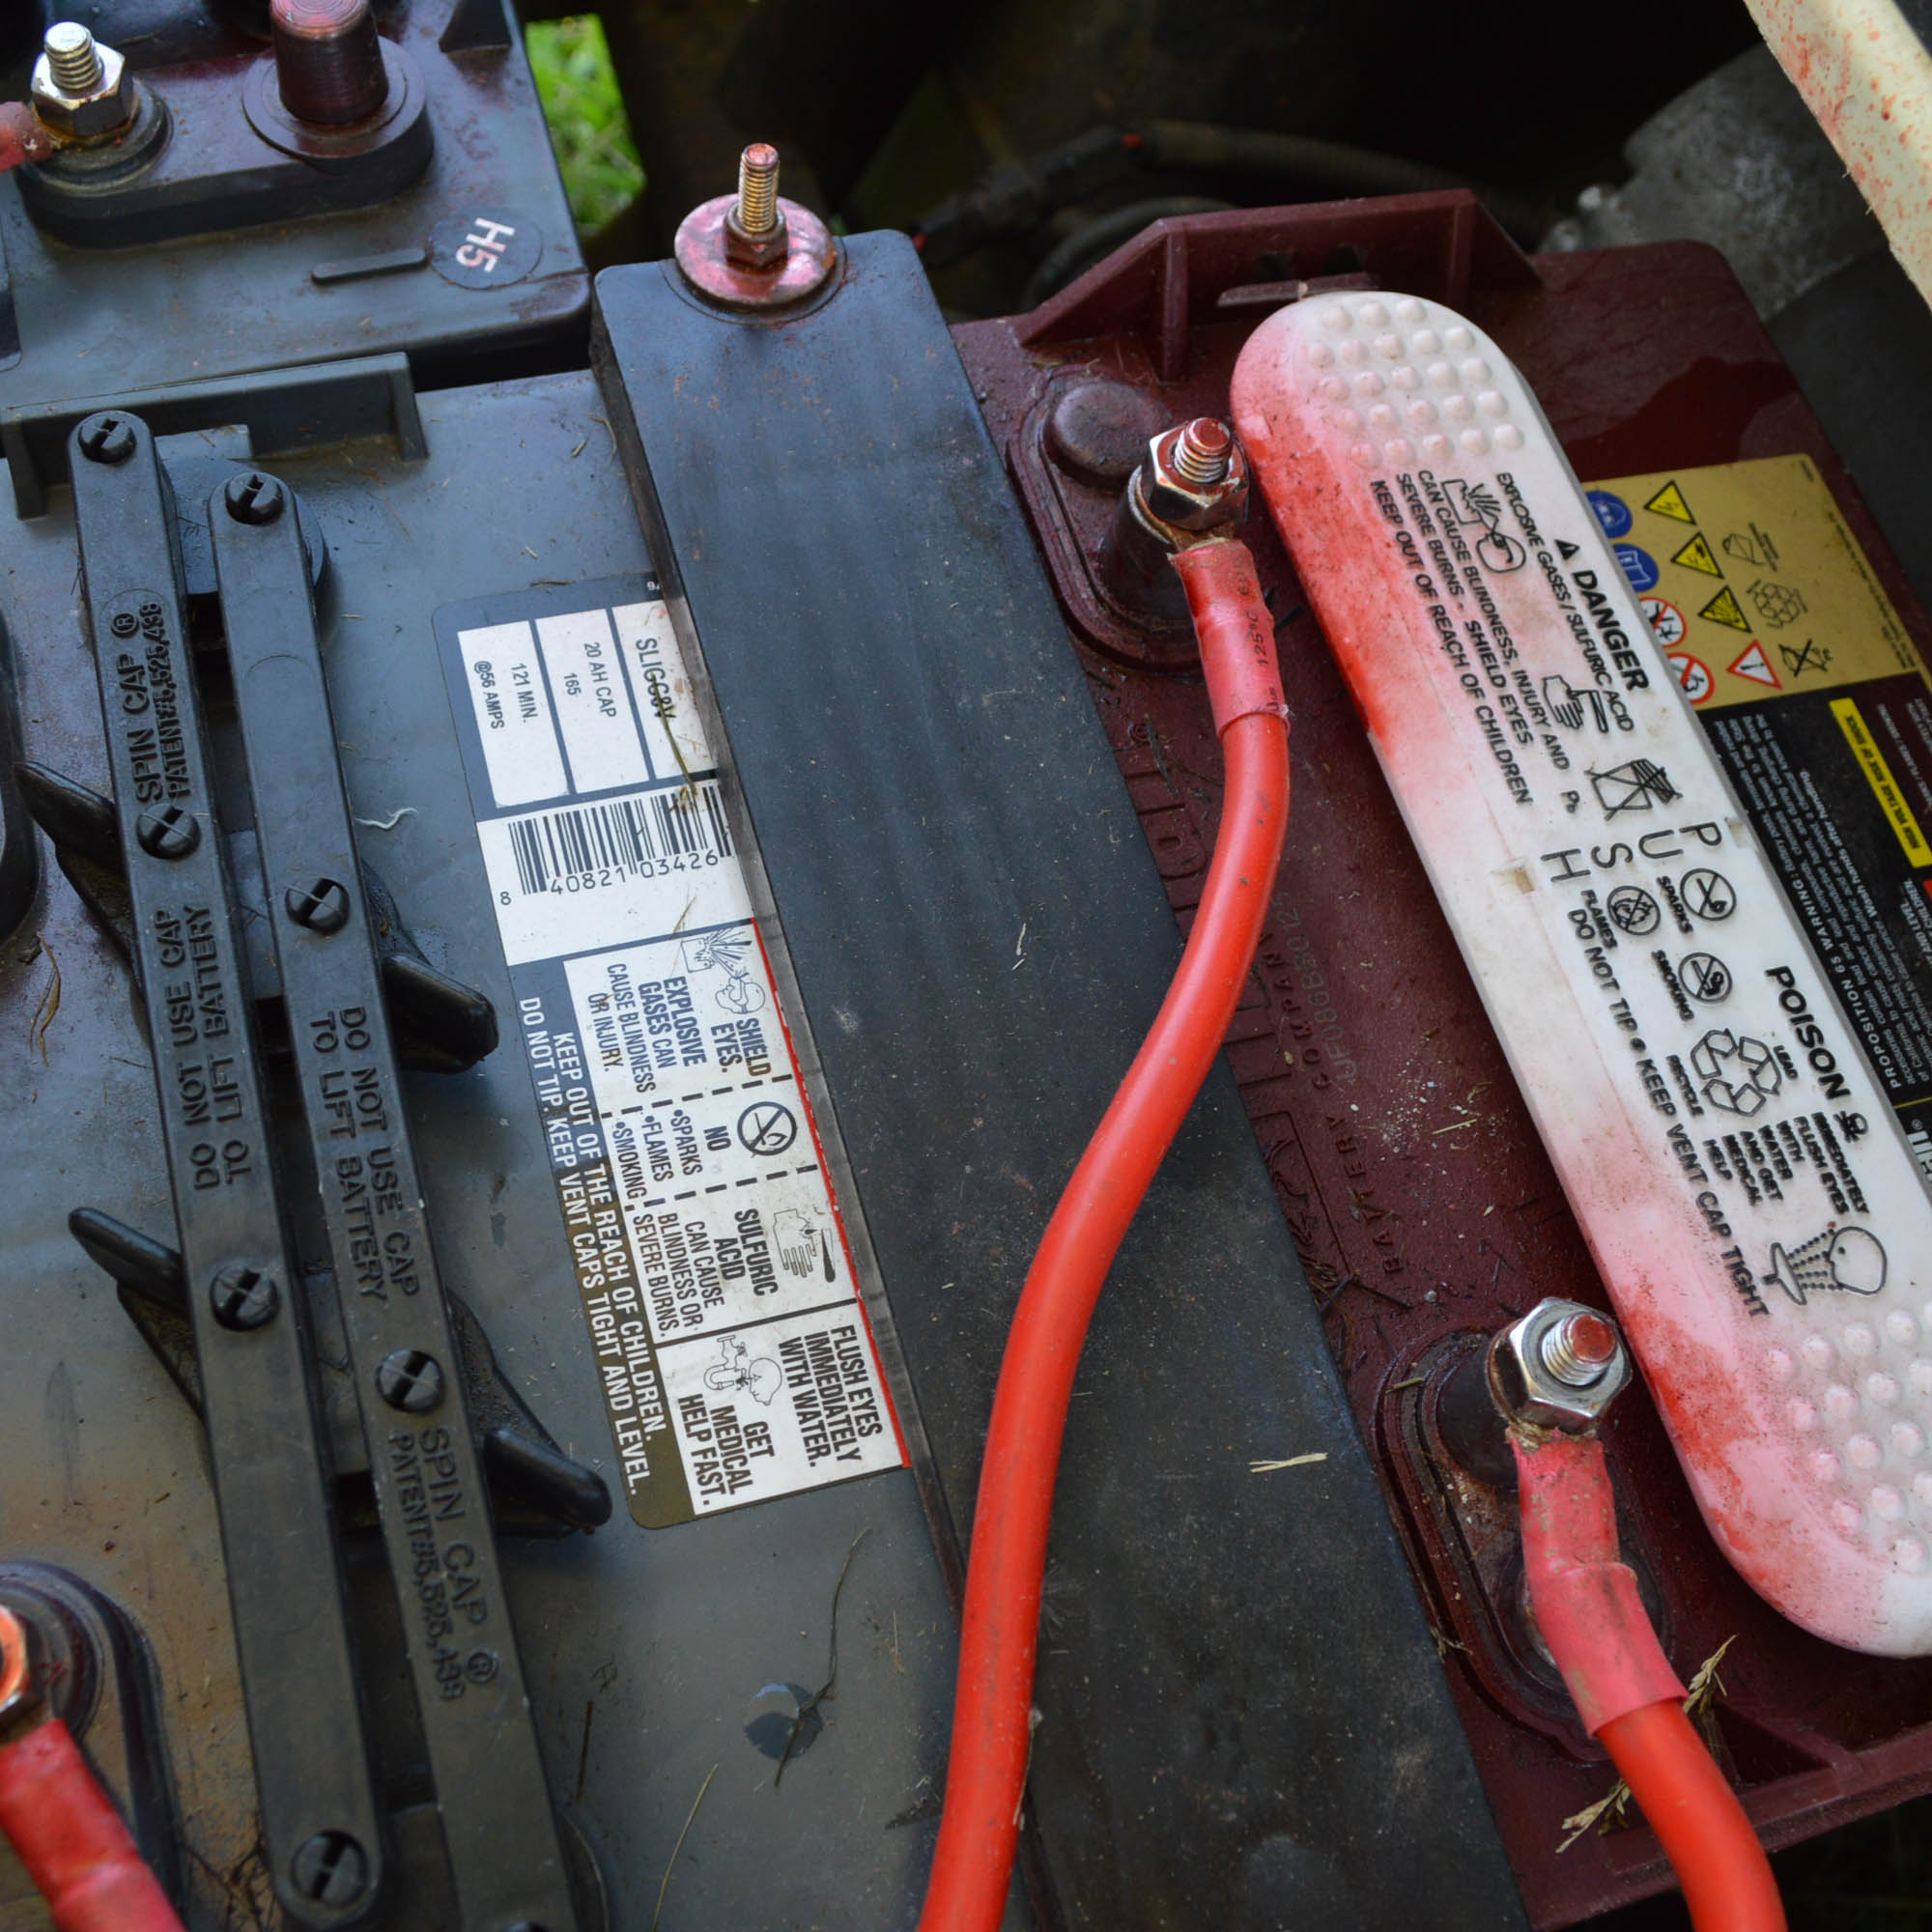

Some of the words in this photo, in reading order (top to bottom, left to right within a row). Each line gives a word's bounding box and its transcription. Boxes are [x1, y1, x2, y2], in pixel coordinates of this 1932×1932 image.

[455, 217, 515, 273] H5
[1396, 473, 1435, 536] SEVERE
[1427, 539, 1464, 596] BURNS
[1464, 620, 1506, 688] SHIELD
[1498, 694, 1533, 744] EYES
[1418, 469, 1444, 503] CAN
[1435, 506, 1471, 561] CAUSE
[1463, 565, 1518, 665] BLINDNESS,
[1511, 669, 1549, 726] INJURY
[1541, 733, 1569, 769] AND
[1496, 472, 1544, 547] EXPLOSIVE
[1537, 551, 1571, 601] GASES
[1566, 613, 1611, 686] SULFURIC
[1602, 690, 1634, 731] ACID
[1571, 570, 1649, 691] DANGER
[583, 641, 602, 658] 20
[588, 662, 608, 682] AH
[1370, 480, 1405, 526] KEEP
[1394, 531, 1426, 573] OUT
[1414, 574, 1438, 600] OF
[1428, 604, 1469, 668] REACH
[1461, 673, 1487, 701] OF
[1475, 704, 1531, 807] CHILDREN
[116, 653, 151, 715] CAP
[473, 660, 496, 688] @56
[485, 692, 504, 728] AMPS
[511, 663, 530, 686] 121
[563, 672, 581, 695] 165
[595, 686, 616, 717] CAP
[515, 689, 539, 724] MIN.
[128, 726, 164, 805] SPIN
[1822, 819, 1843, 846] after
[499, 891, 512, 906] 8
[550, 867, 627, 895] 40821
[639, 848, 719, 879] 03426
[1836, 848, 1861, 883] hands
[1577, 888, 1621, 950] FLAMES
[1654, 874, 1695, 934] SPARKS
[1854, 884, 1879, 917] Wash
[152, 906, 187, 970] CAP
[1829, 955, 1846, 973] 65
[182, 900, 229, 1037] BATTERY
[605, 961, 637, 1011] CAUSE
[1648, 949, 1696, 1022] SMOKING
[163, 980, 200, 1048] USE
[340, 1006, 371, 1053] DO
[517, 995, 546, 1028] DO
[585, 990, 611, 1016] OR
[636, 979, 672, 1037] GASES
[662, 974, 708, 1068] EXPLOSIVE
[307, 1010, 341, 1056] TO
[525, 1028, 555, 1071] NOT
[550, 1030, 583, 1084] KEEP
[591, 1014, 624, 1072] INJURY.
[617, 1010, 657, 1094] BLINDNESS
[650, 1037, 677, 1070] CAN
[709, 1021, 744, 1074] EYES.
[734, 1014, 773, 1079] SHIELD
[1763, 964, 1852, 1101] POISON
[1839, 978, 1902, 1089] PROPOSITION
[206, 1050, 243, 1123] LIFT
[1771, 1044, 1800, 1080] LEAD
[175, 1058, 212, 1126] NOT
[317, 1069, 357, 1143] LIFT
[349, 1065, 388, 1135] NOT
[535, 1073, 565, 1114] TIP.
[562, 1084, 595, 1130] OUT
[1565, 908, 1597, 941] DO
[1581, 946, 1622, 993] NOT
[1606, 999, 1640, 1034] TIP
[1633, 1059, 1679, 1119] KEEP
[1662, 1124, 1711, 1187] VENT
[1691, 1191, 1735, 1240] CAP
[1719, 1247, 1772, 1320] TIGHT
[187, 1140, 222, 1191] DO
[219, 1137, 253, 1184] TO
[545, 1115, 579, 1170] KEEP
[574, 1130, 602, 1162] OF
[701, 1123, 732, 1153] NO
[1701, 1138, 1734, 1181] HELP
[1755, 1124, 1795, 1181] WATER
[1791, 1115, 1830, 1170] FLUSH
[1818, 1171, 1851, 1214] EYES
[364, 1146, 403, 1215] USE
[557, 1171, 592, 1229] VENT
[582, 1163, 612, 1207] THE
[1754, 1167, 1784, 1203] GET
[332, 1157, 387, 1302] BATTERY
[591, 1208, 630, 1282] REACH
[631, 1212, 666, 1275] SEVERE
[682, 1219, 712, 1255] CAN
[712, 1234, 747, 1282] ACID
[732, 1206, 780, 1298] SULFURIC
[381, 1229, 420, 1299] CAP
[569, 1231, 606, 1291] CAPS
[656, 1211, 697, 1301] BLINDNESS
[678, 1300, 704, 1328] OR
[692, 1254, 725, 1310] CAUSE
[584, 1292, 622, 1360] TIGHT
[610, 1284, 639, 1317] OF
[645, 1273, 681, 1338] BURNS.
[617, 1319, 668, 1442] CHILDREN.
[776, 1335, 813, 1390] WITH
[829, 1322, 869, 1387] FLUSH
[600, 1361, 635, 1413] AND
[803, 1328, 862, 1466] IMMEDIATELY
[846, 1385, 884, 1439] EYES
[676, 1392, 713, 1445] HELP
[741, 1419, 775, 1463] GET
[790, 1388, 835, 1468] WATER.
[415, 1425, 468, 1522] SPIN
[612, 1415, 653, 1495] LEVEL.
[690, 1445, 727, 1506] FAST.
[708, 1404, 754, 1495] MEDICAL
[440, 1541, 490, 1628] CAP
